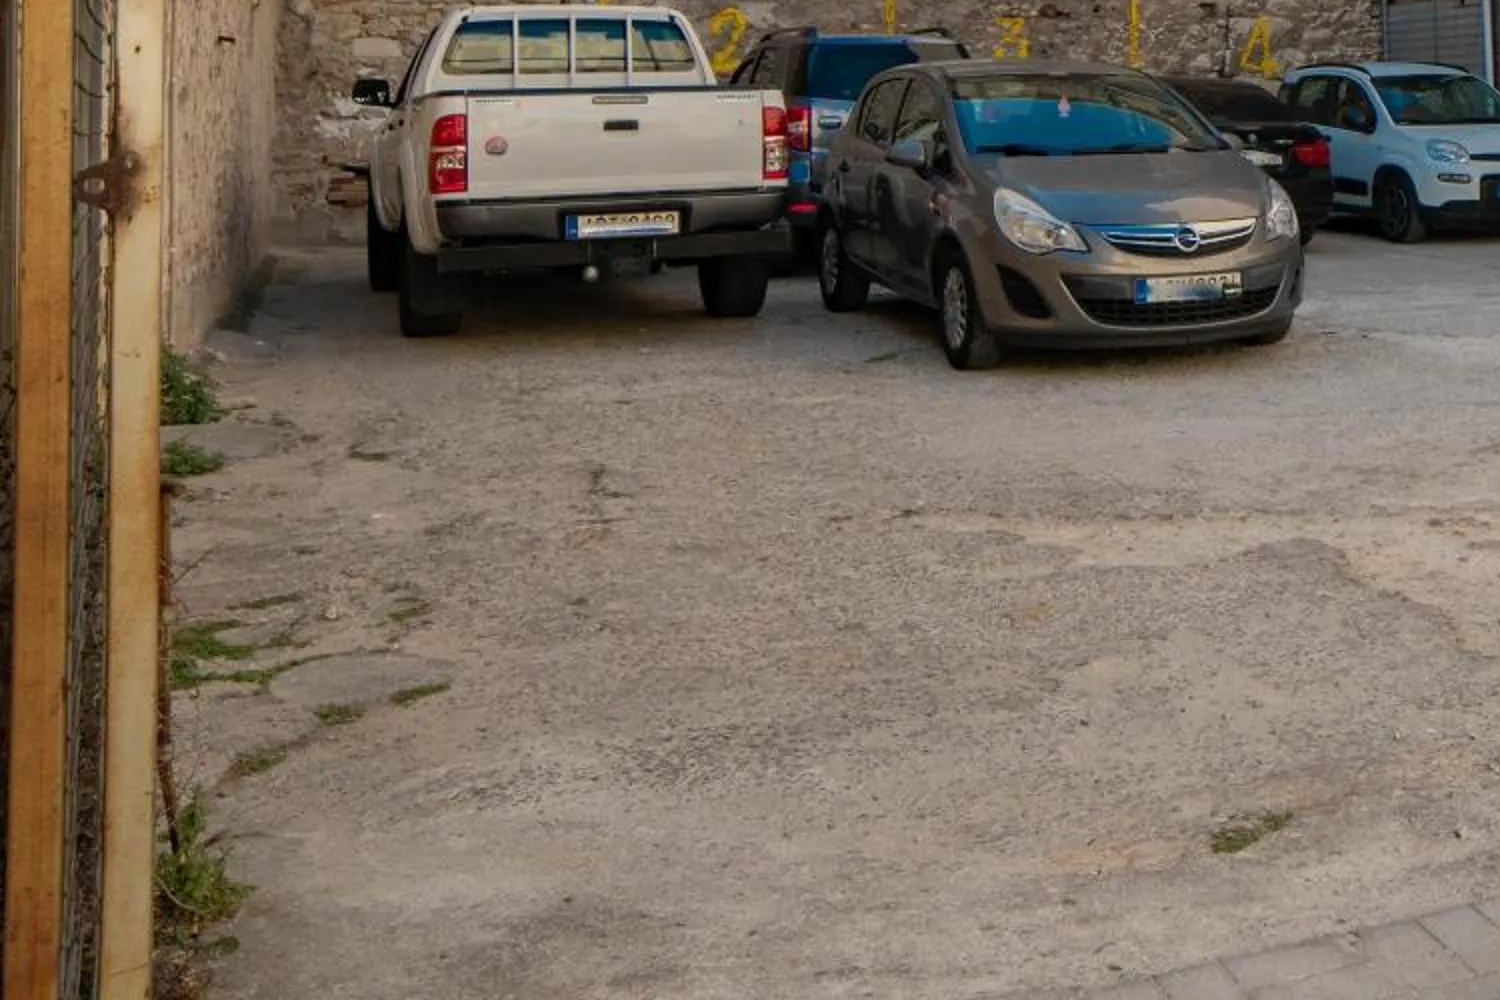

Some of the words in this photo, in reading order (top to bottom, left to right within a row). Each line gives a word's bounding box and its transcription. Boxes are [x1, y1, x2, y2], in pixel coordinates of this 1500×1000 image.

[709, 8, 747, 76] 2
[992, 17, 1031, 58] 3
[1239, 15, 1280, 78] 4
